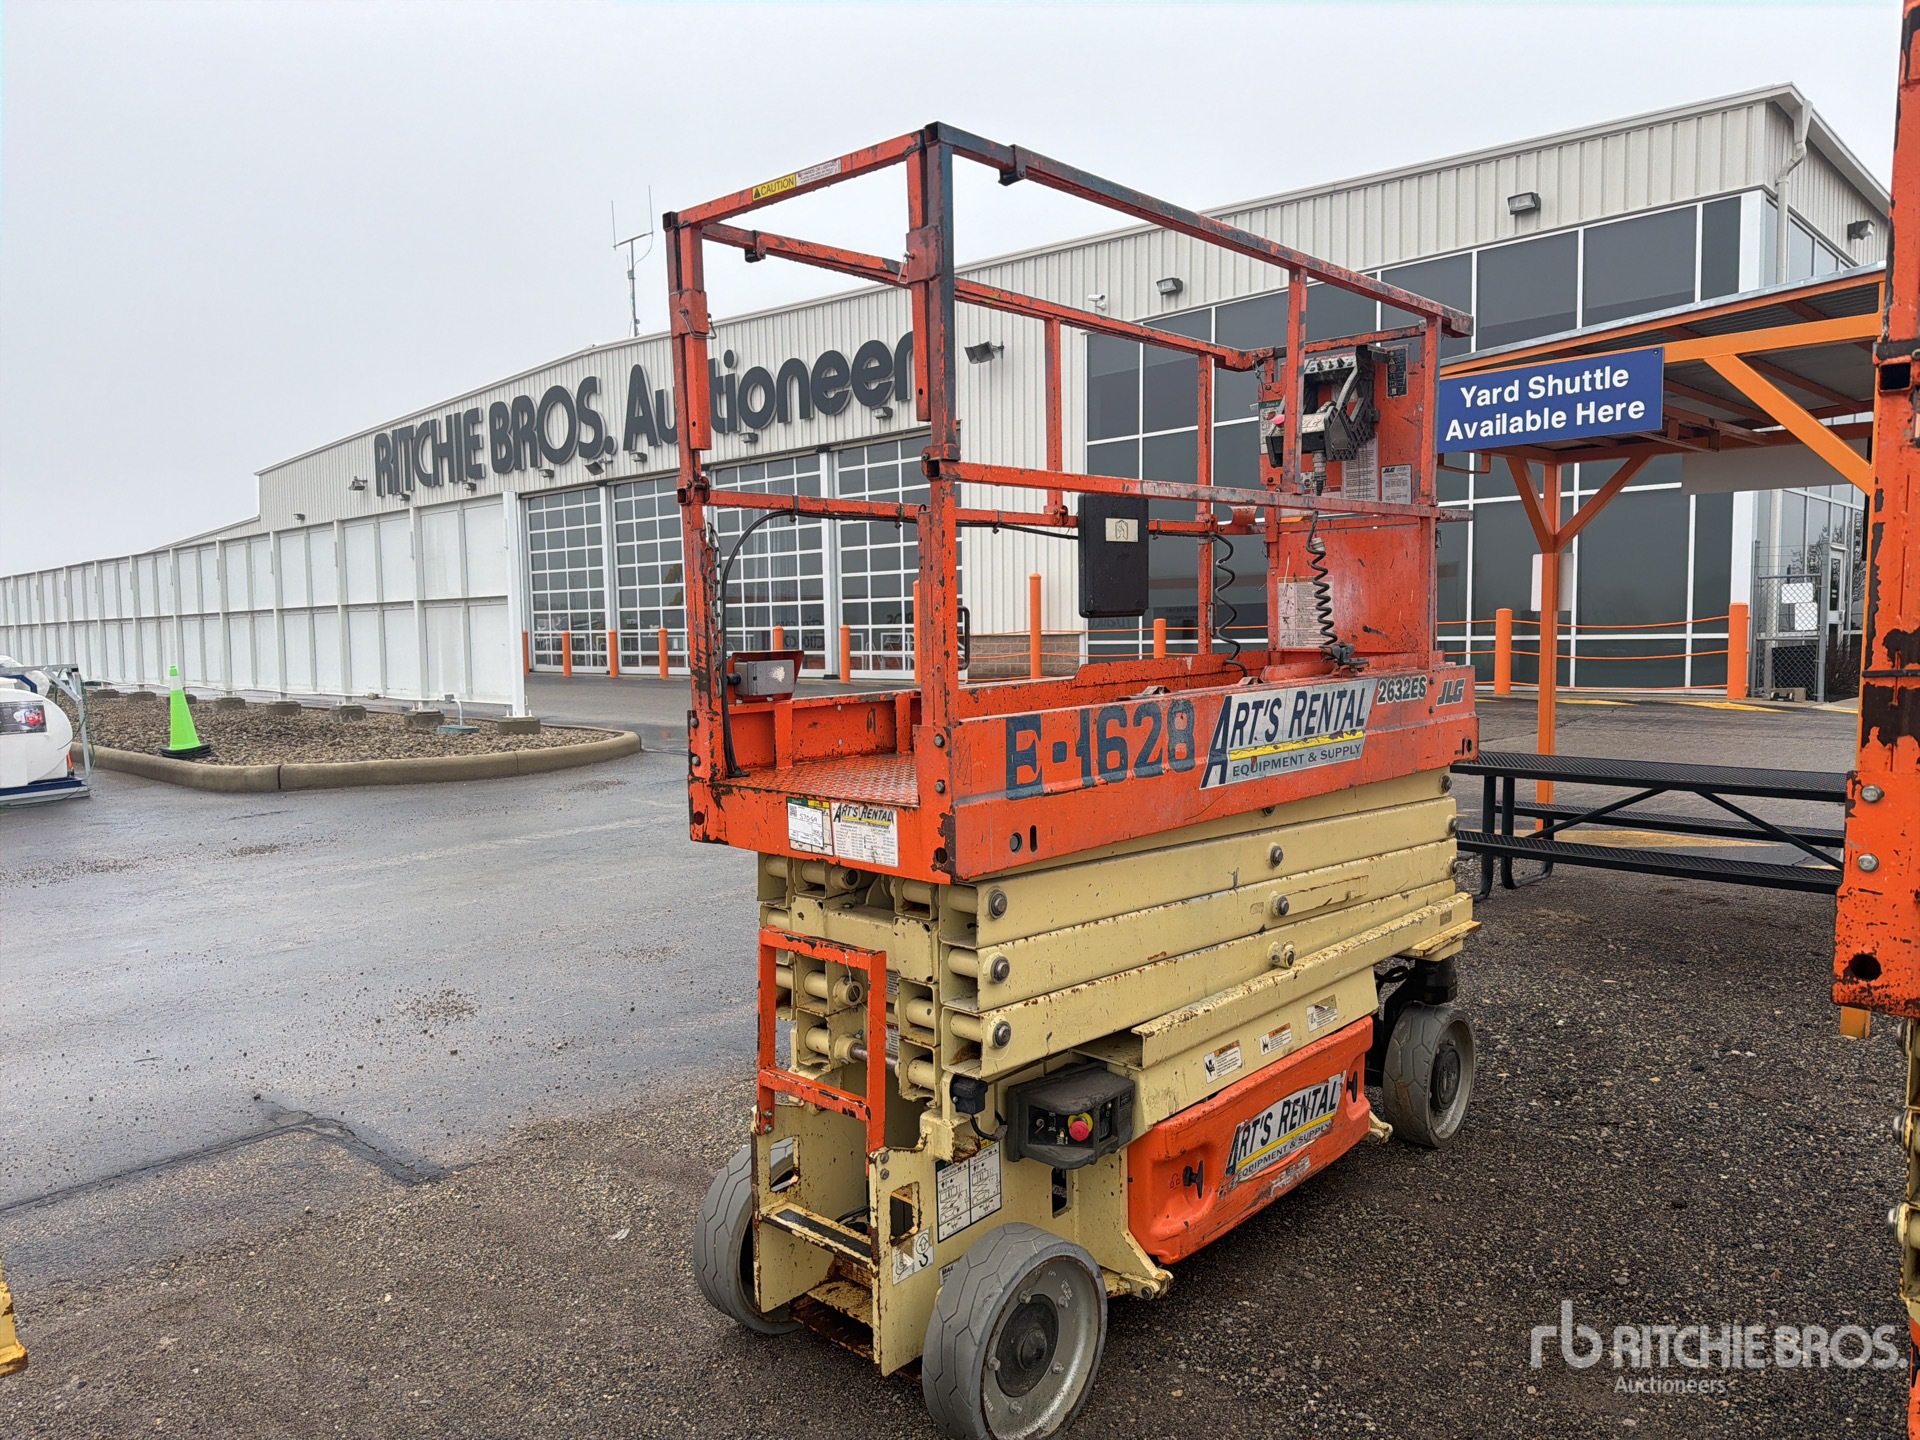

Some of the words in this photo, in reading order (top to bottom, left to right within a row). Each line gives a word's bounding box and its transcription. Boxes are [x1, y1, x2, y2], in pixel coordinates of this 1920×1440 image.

[760, 177, 794, 195] CAUTION
[1460, 379, 1520, 408] Yard
[1528, 365, 1629, 399] Shuttle
[374, 407, 486, 497] RITCHIE
[489, 376, 616, 474] BROS.
[1445, 407, 1567, 442] Available
[1576, 400, 1645, 426] Here
[1377, 676, 1427, 704] 2632ES
[1436, 678, 1466, 706] JLG
[1200, 694, 1282, 788] ART'S
[1288, 688, 1366, 739] RENTAL
[1232, 753, 1303, 777] EQUIPMENT
[1307, 752, 1317, 762] &
[1320, 744, 1362, 760] SUPPLY
[833, 803, 858, 823] ART'S
[861, 804, 892, 822] RENTAL
[1277, 1081, 1338, 1138] RENTAL
[1237, 1145, 1287, 1180] EQUIPMENT
[1289, 1140, 1296, 1149] &
[1298, 1122, 1331, 1144] SUPPLY
